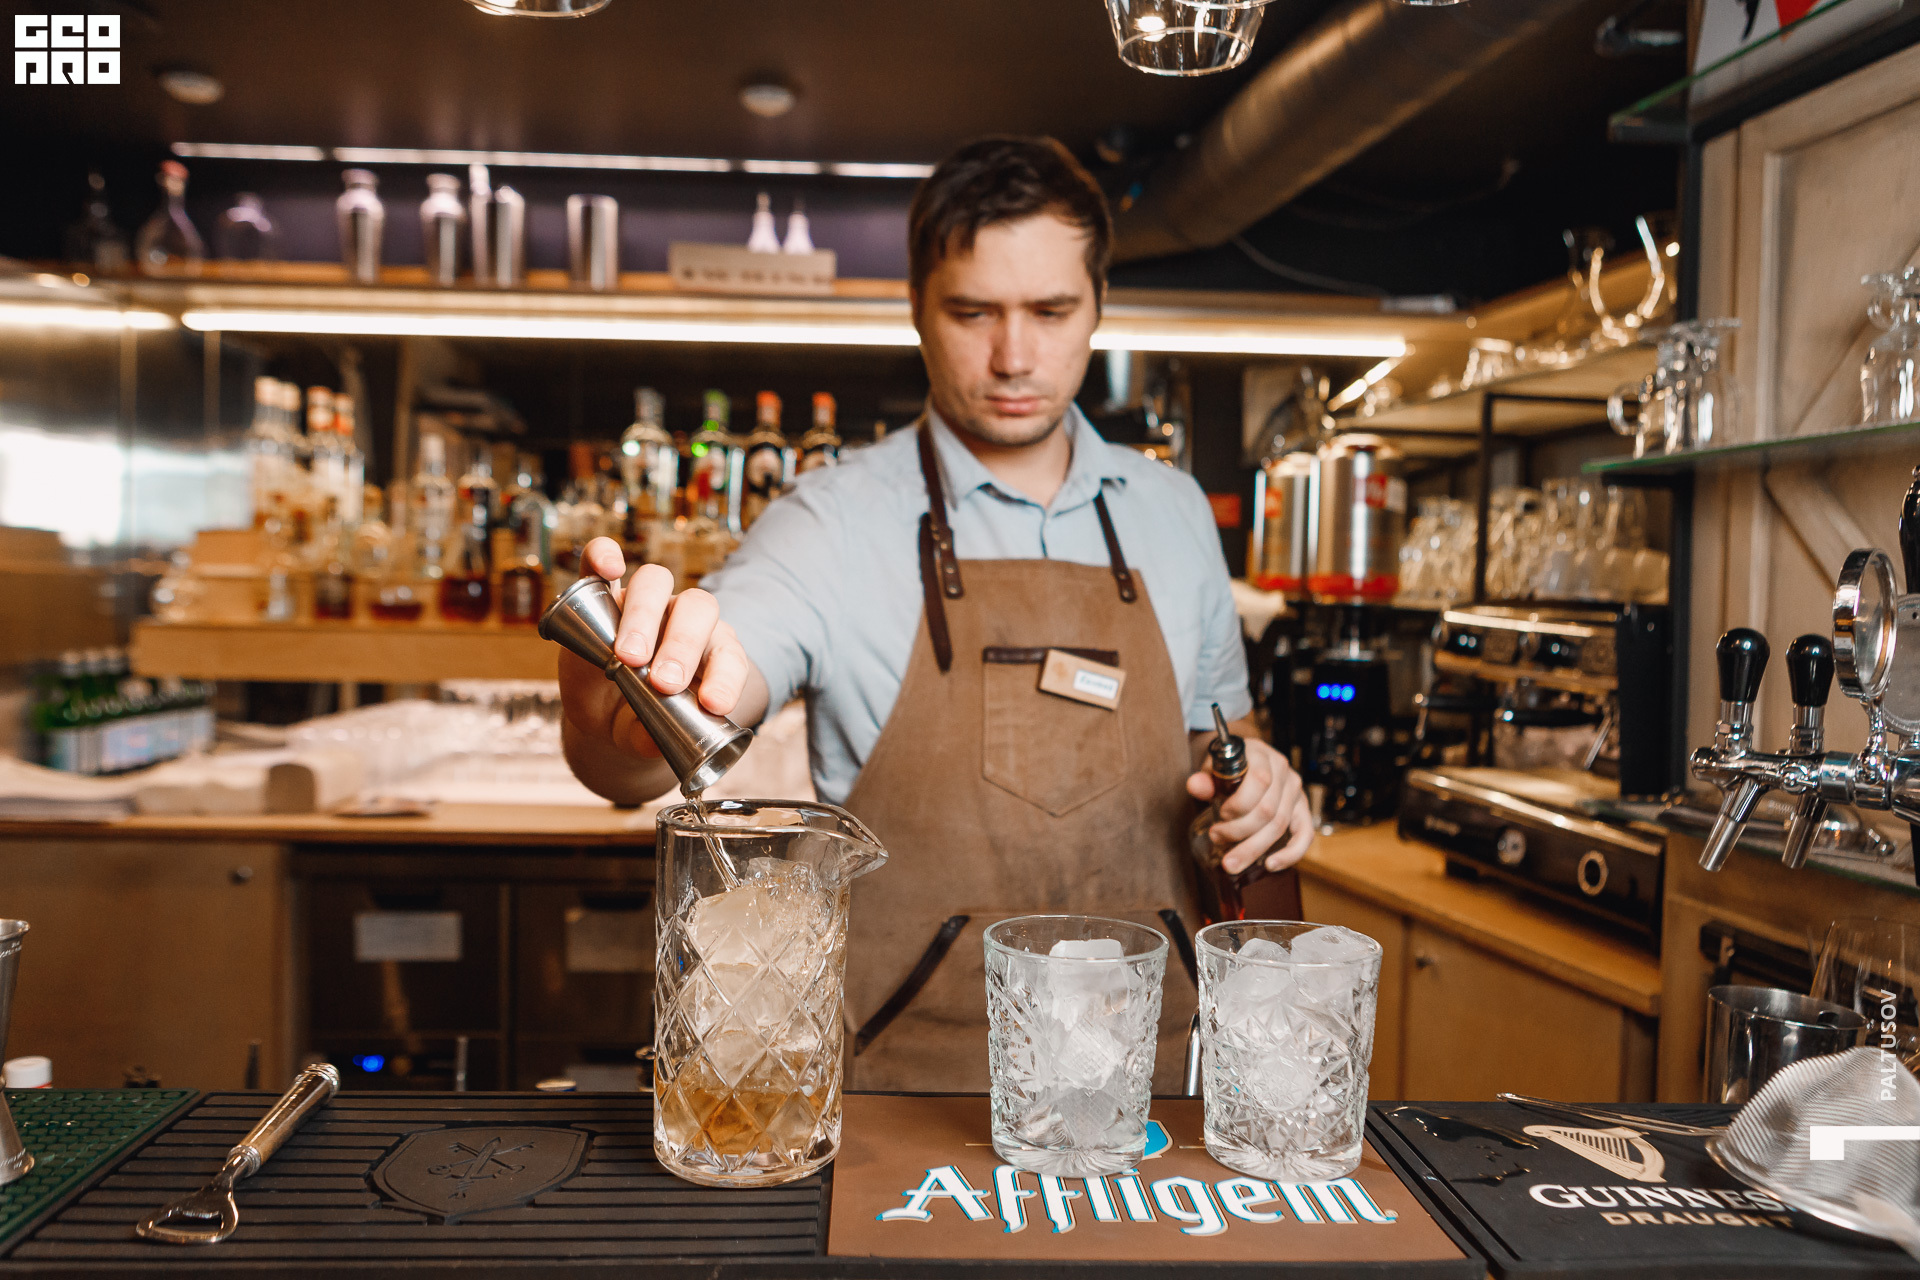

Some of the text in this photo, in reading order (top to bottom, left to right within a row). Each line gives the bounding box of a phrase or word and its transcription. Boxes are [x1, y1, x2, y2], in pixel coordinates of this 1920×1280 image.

[875, 1164, 1398, 1237] Affligem
[1528, 1183, 1798, 1212] GUINNES
[1599, 1210, 1794, 1229] DRAUGHT
